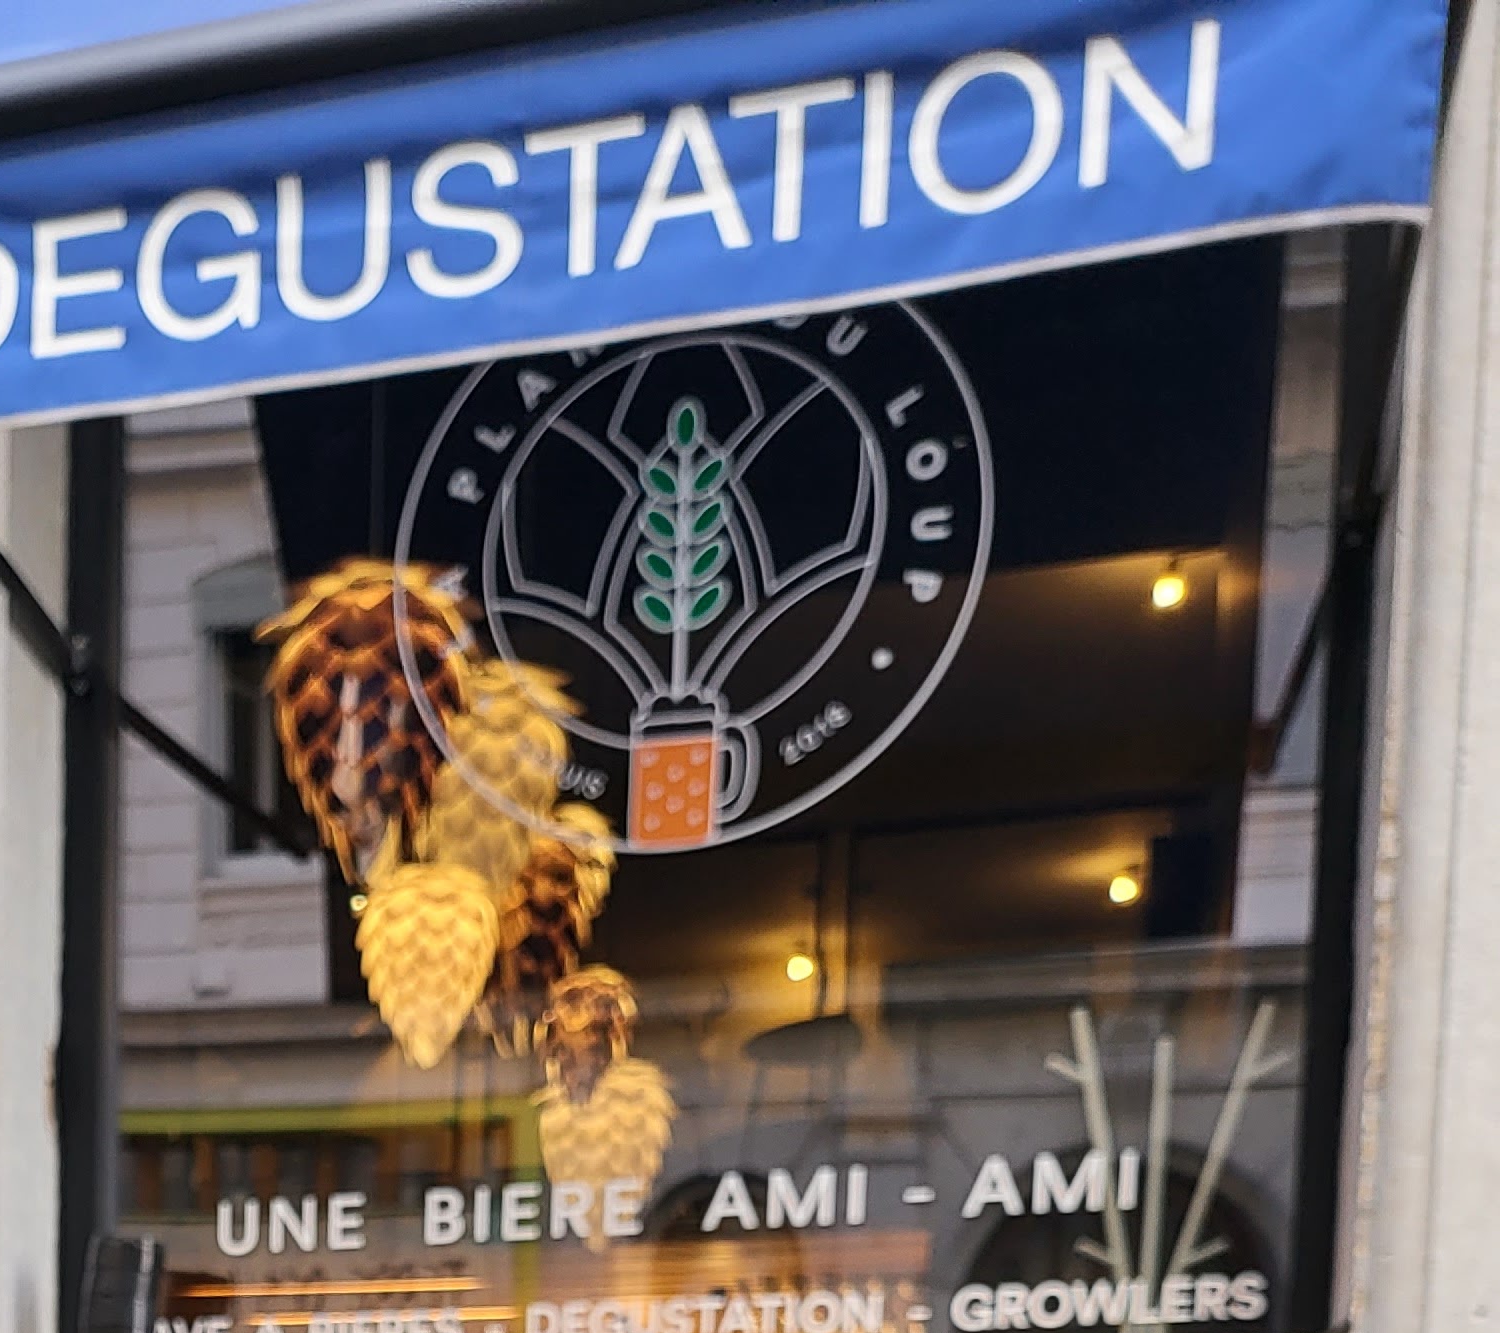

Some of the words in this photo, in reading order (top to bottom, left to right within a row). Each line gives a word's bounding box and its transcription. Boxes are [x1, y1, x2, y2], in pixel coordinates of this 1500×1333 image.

[885, 384, 955, 603] LOUP
[216, 1191, 368, 1257] UNE
[423, 1175, 645, 1248] BIERE
[700, 1163, 869, 1233] AMI
[960, 1145, 1141, 1219] AMI
[948, 1269, 1270, 1333] GROWLERS
